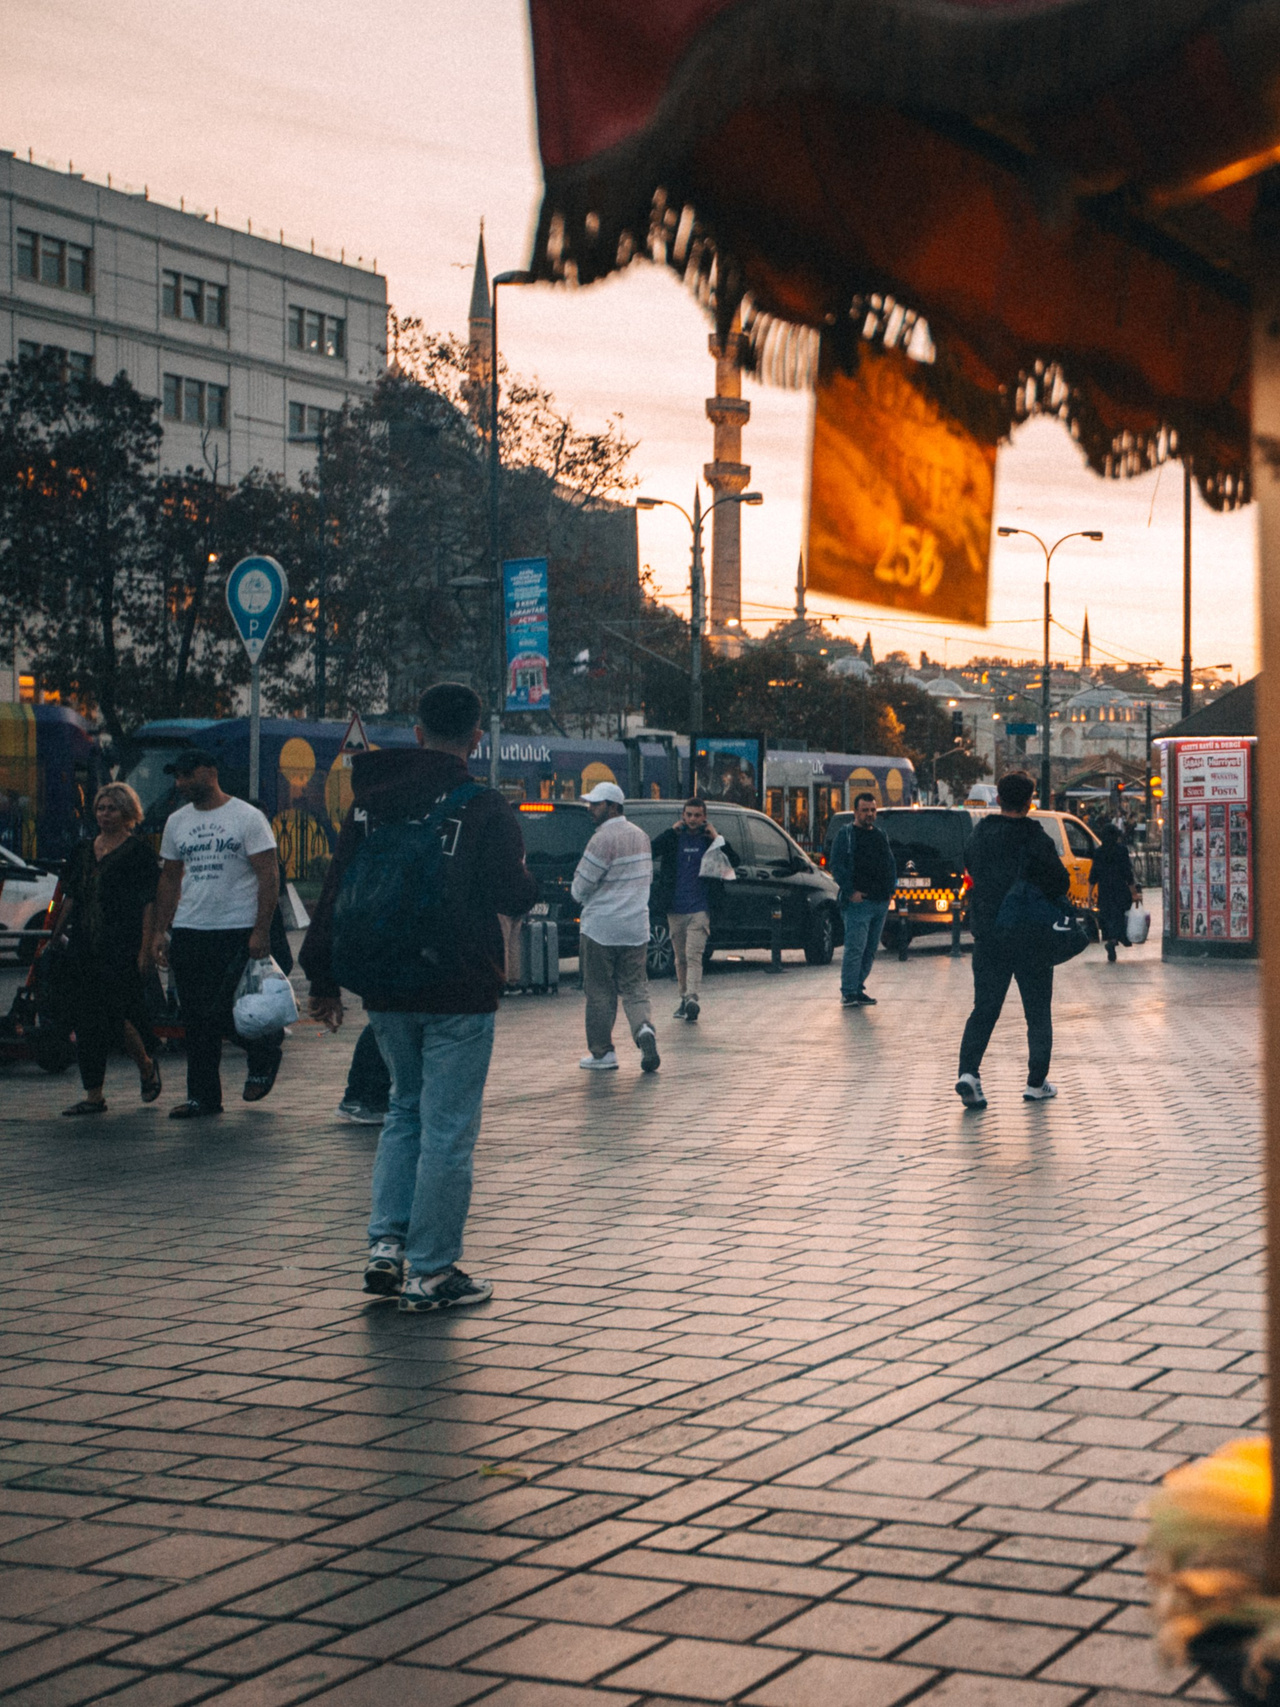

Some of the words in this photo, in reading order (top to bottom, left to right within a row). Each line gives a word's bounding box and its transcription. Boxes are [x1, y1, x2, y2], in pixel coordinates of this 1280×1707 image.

[249, 619, 259, 639] P
[1211, 787, 1238, 796] POSTA
[209, 823, 226, 833] CITY
[215, 837, 242, 853] Way
